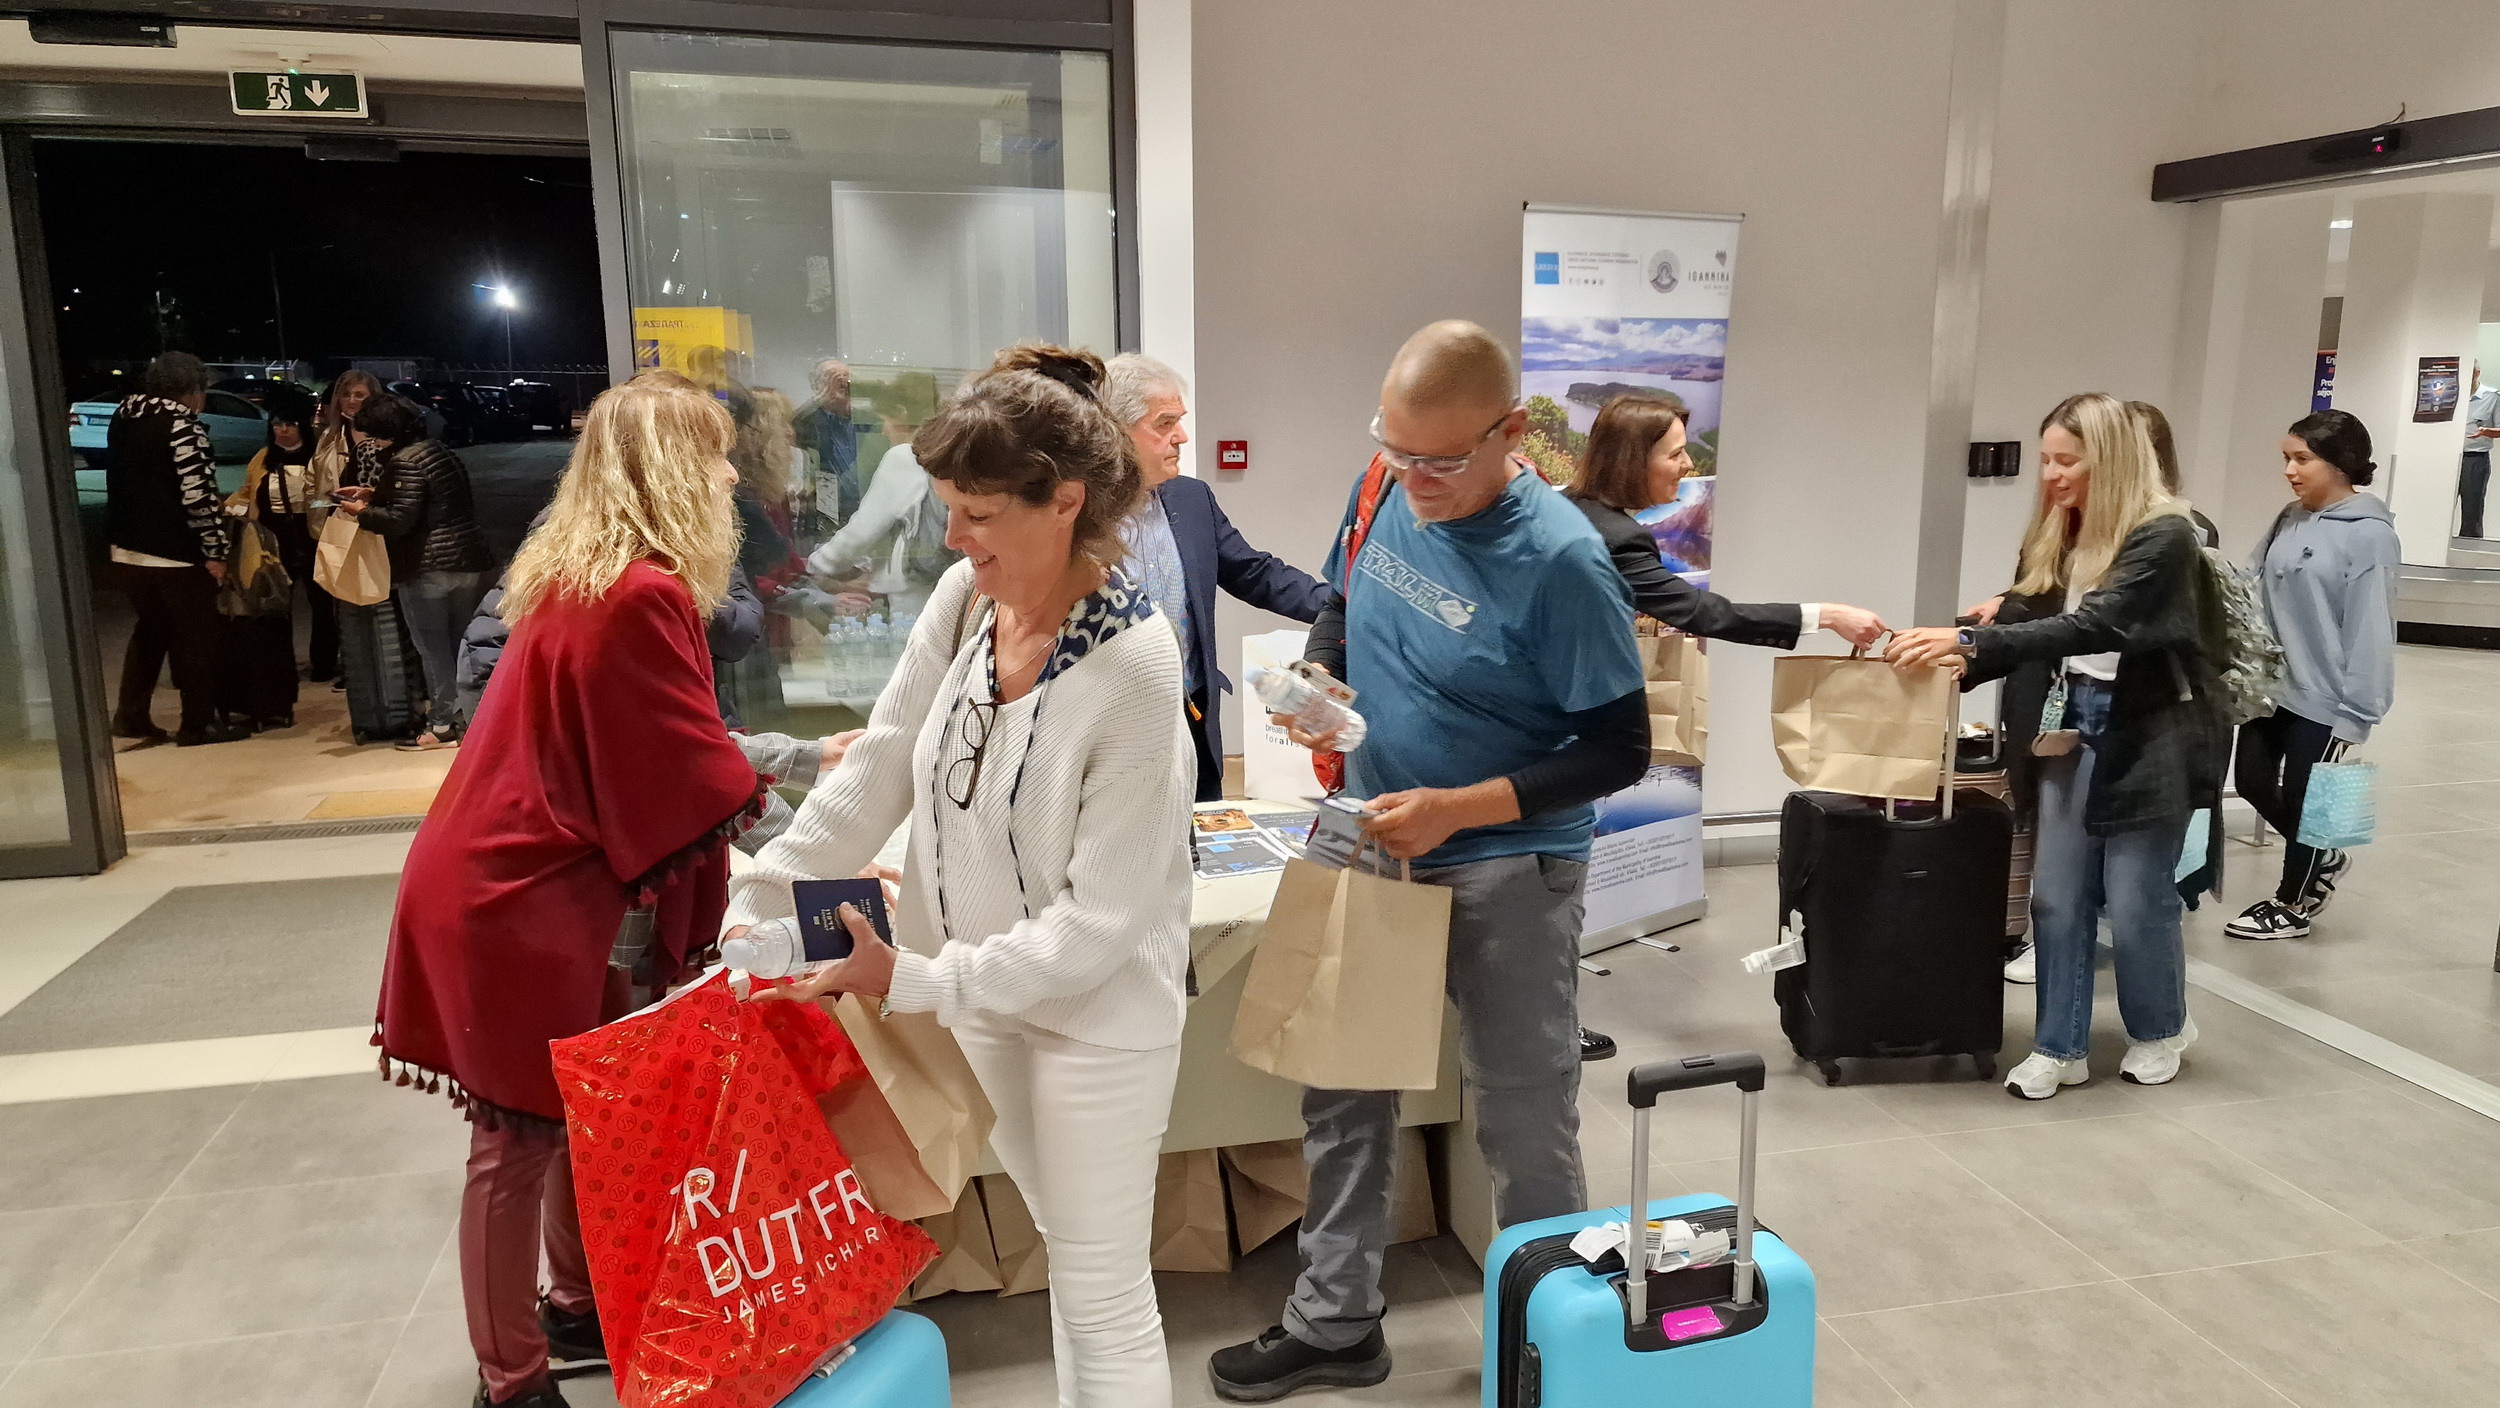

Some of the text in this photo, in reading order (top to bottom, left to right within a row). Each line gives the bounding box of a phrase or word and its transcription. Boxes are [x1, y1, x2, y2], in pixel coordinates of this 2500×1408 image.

[2320, 379, 2334, 387] Pro
[1265, 723, 1289, 735] breatht
[722, 1276, 807, 1324] JAMES
